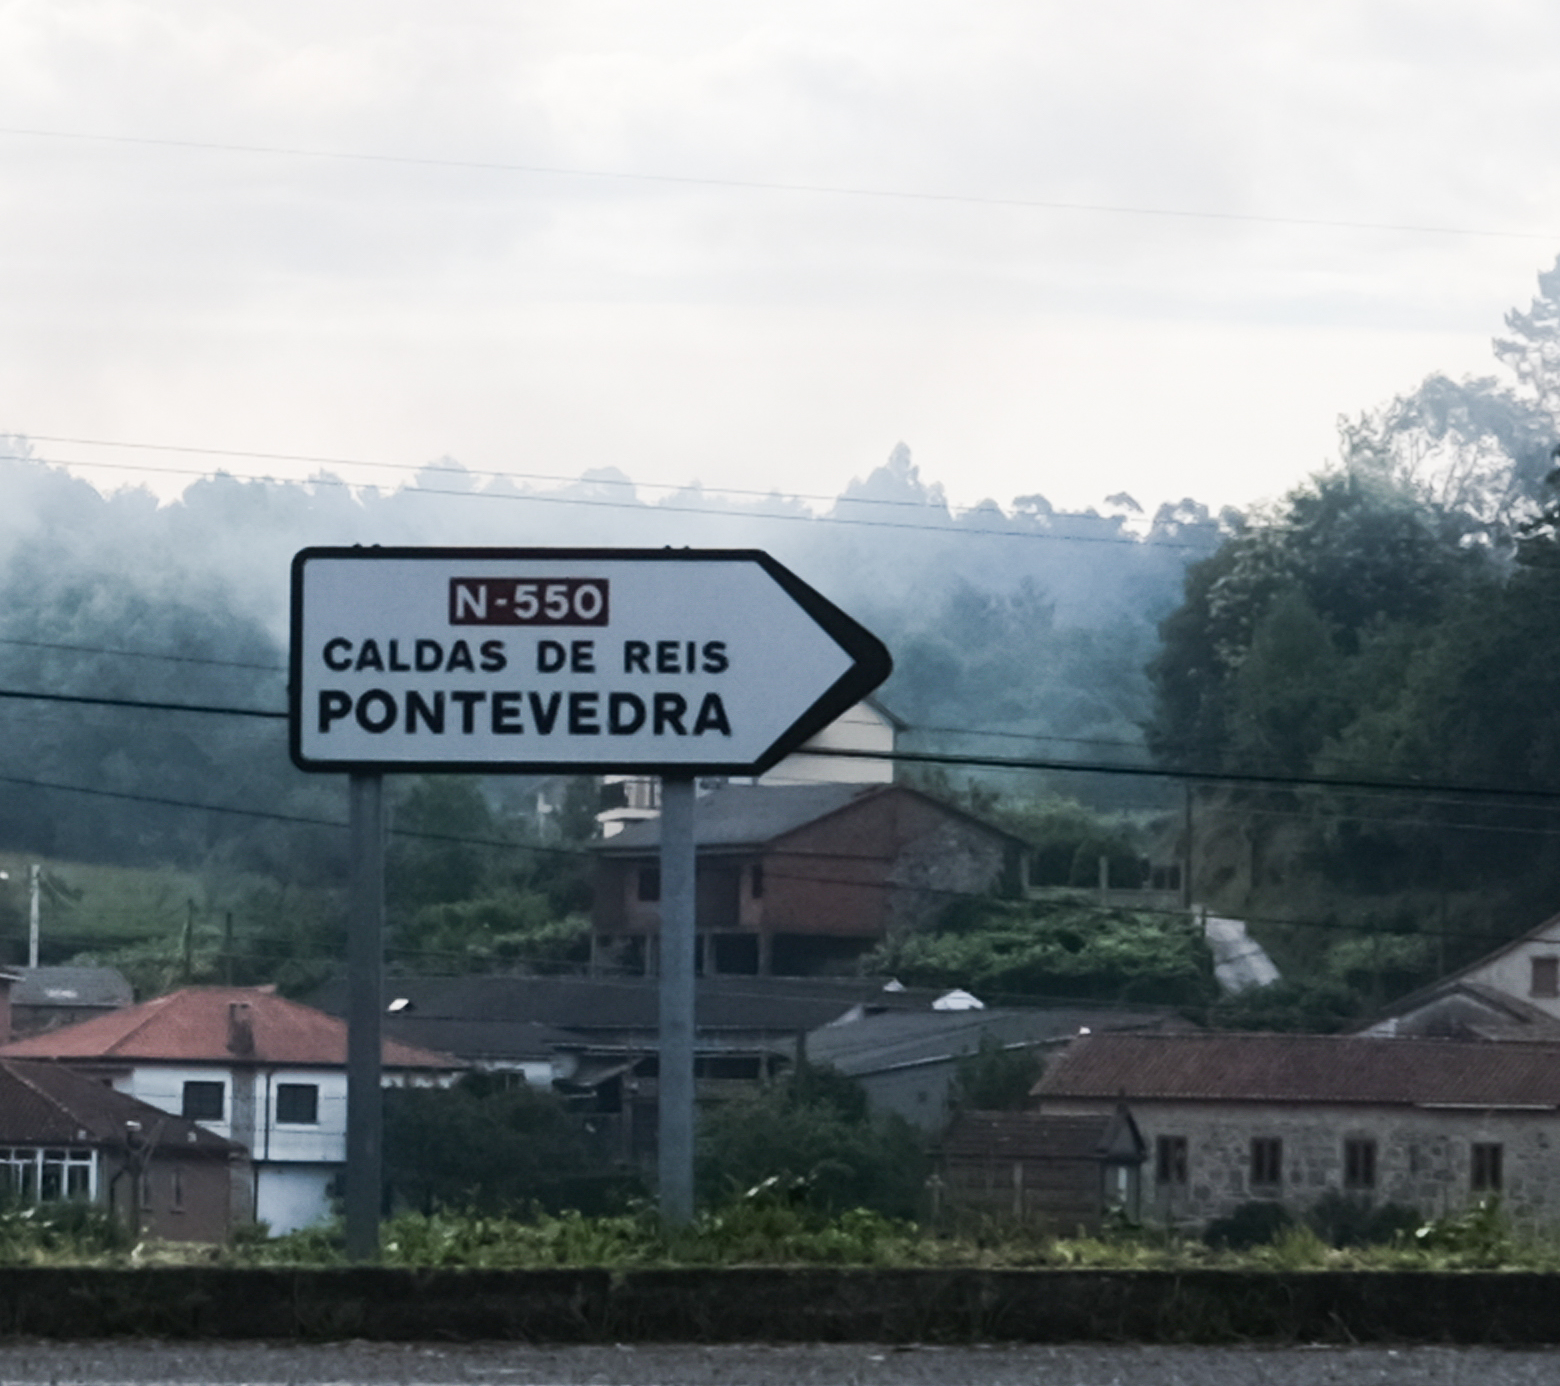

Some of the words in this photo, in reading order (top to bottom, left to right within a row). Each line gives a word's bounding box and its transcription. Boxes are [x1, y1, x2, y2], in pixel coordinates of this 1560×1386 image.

[455, 584, 604, 620] N-550
[322, 637, 507, 673] CALDAS
[537, 640, 595, 673] DE
[624, 640, 729, 674] REIS
[318, 689, 732, 736] PONTEVEDRA
